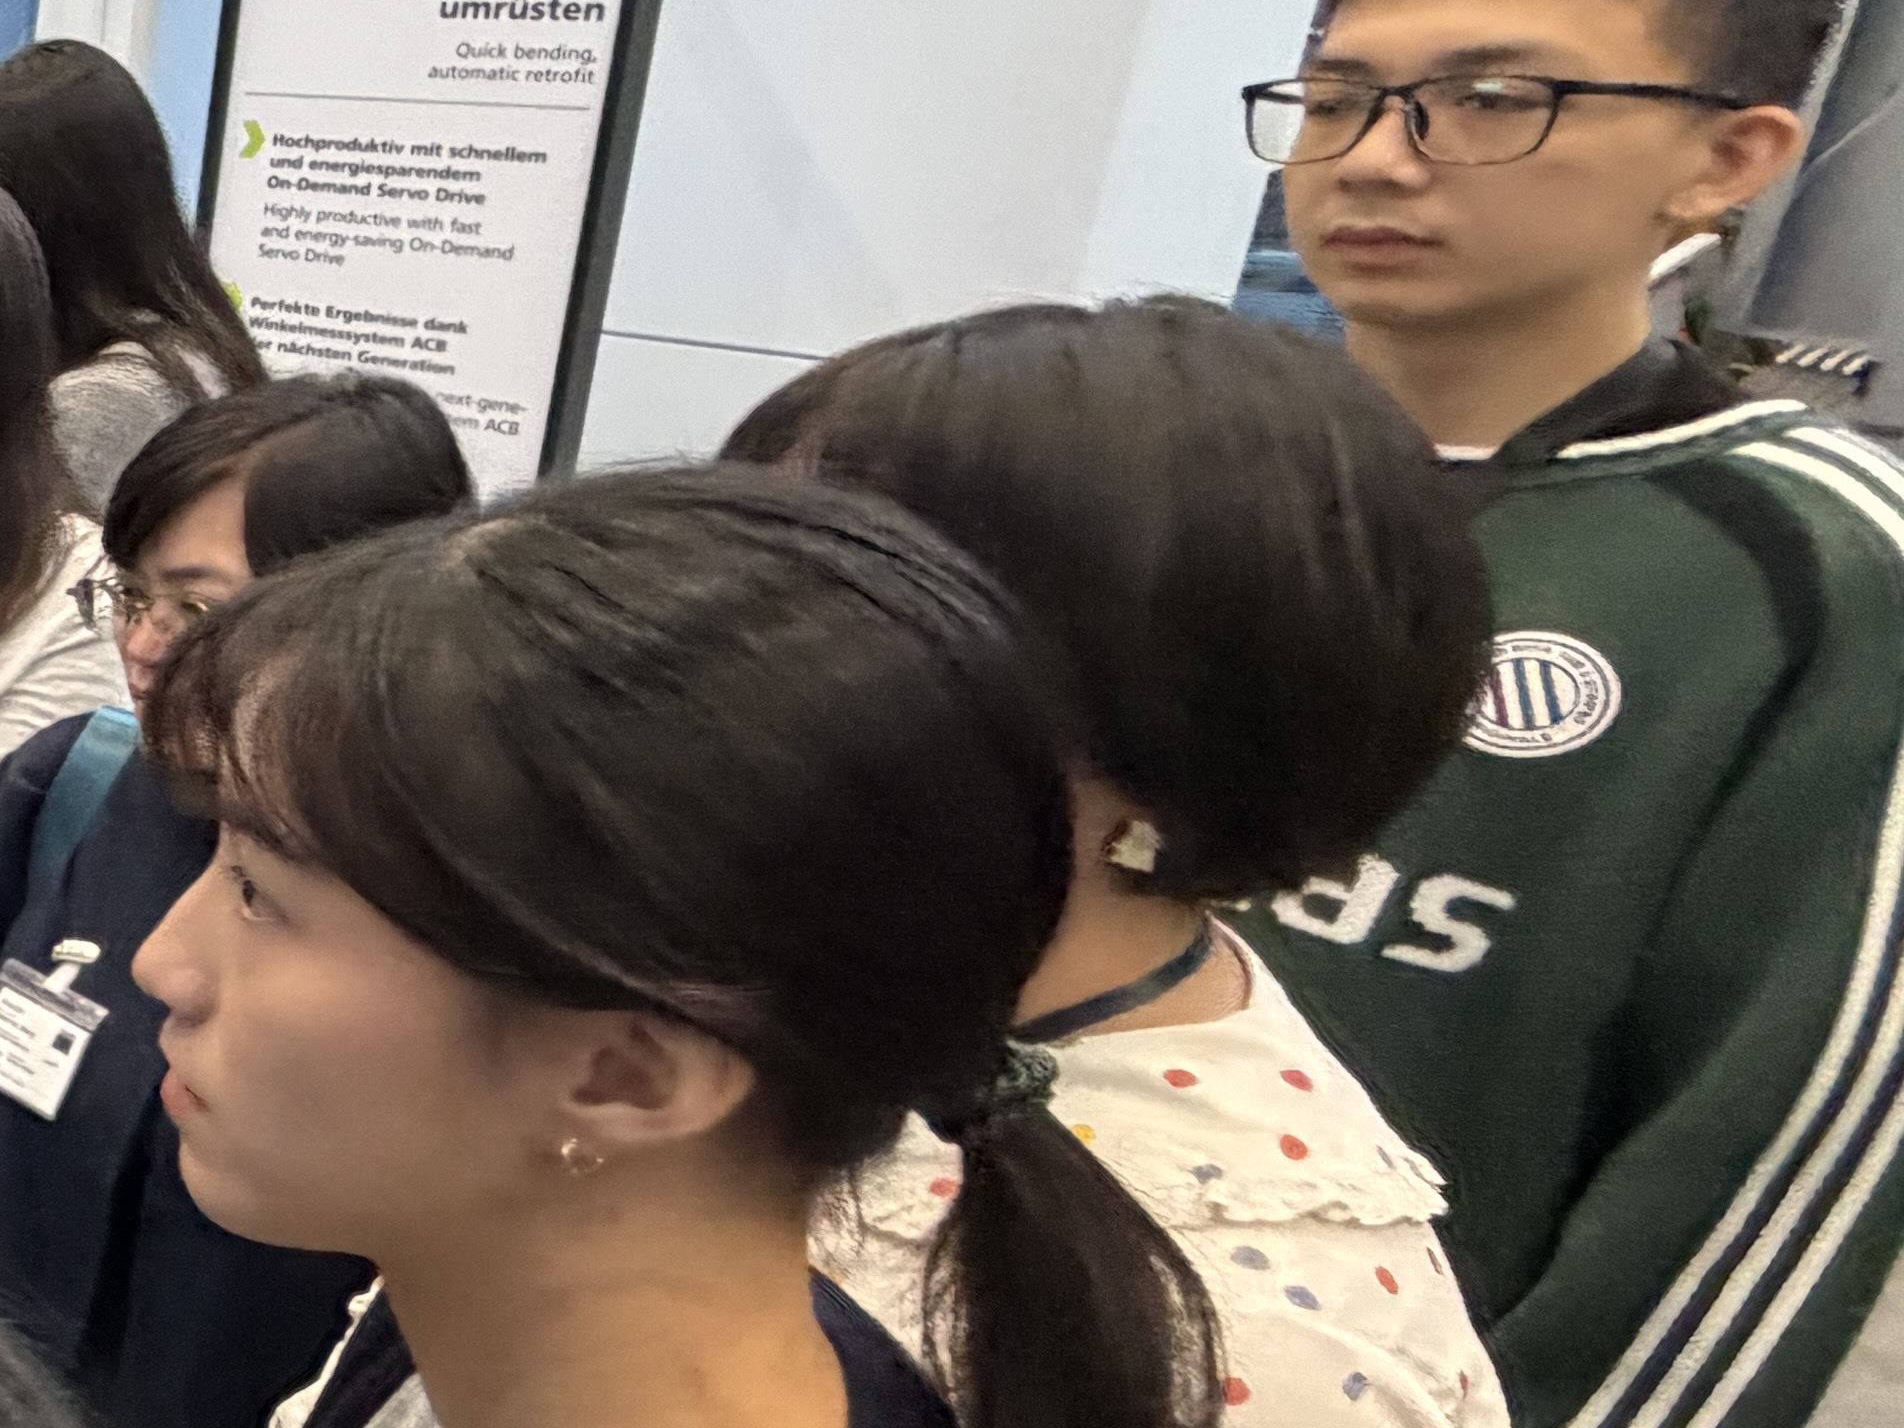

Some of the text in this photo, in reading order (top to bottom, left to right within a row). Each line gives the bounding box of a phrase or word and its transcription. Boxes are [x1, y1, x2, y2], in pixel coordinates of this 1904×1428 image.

[456, 41, 598, 65] Quick bending,
[427, 65, 596, 86] automatic retrofit
[272, 133, 548, 164] Hochproduktiv mit schnellem
[269, 154, 482, 183] und energiesparendem
[267, 175, 487, 206] On-Demand Servo Drive
[263, 203, 482, 236] Highly productive with fast
[258, 243, 345, 267] Servo Drive
[260, 225, 515, 262] and energy-saving On-Demand
[251, 296, 320, 317] Perfekte
